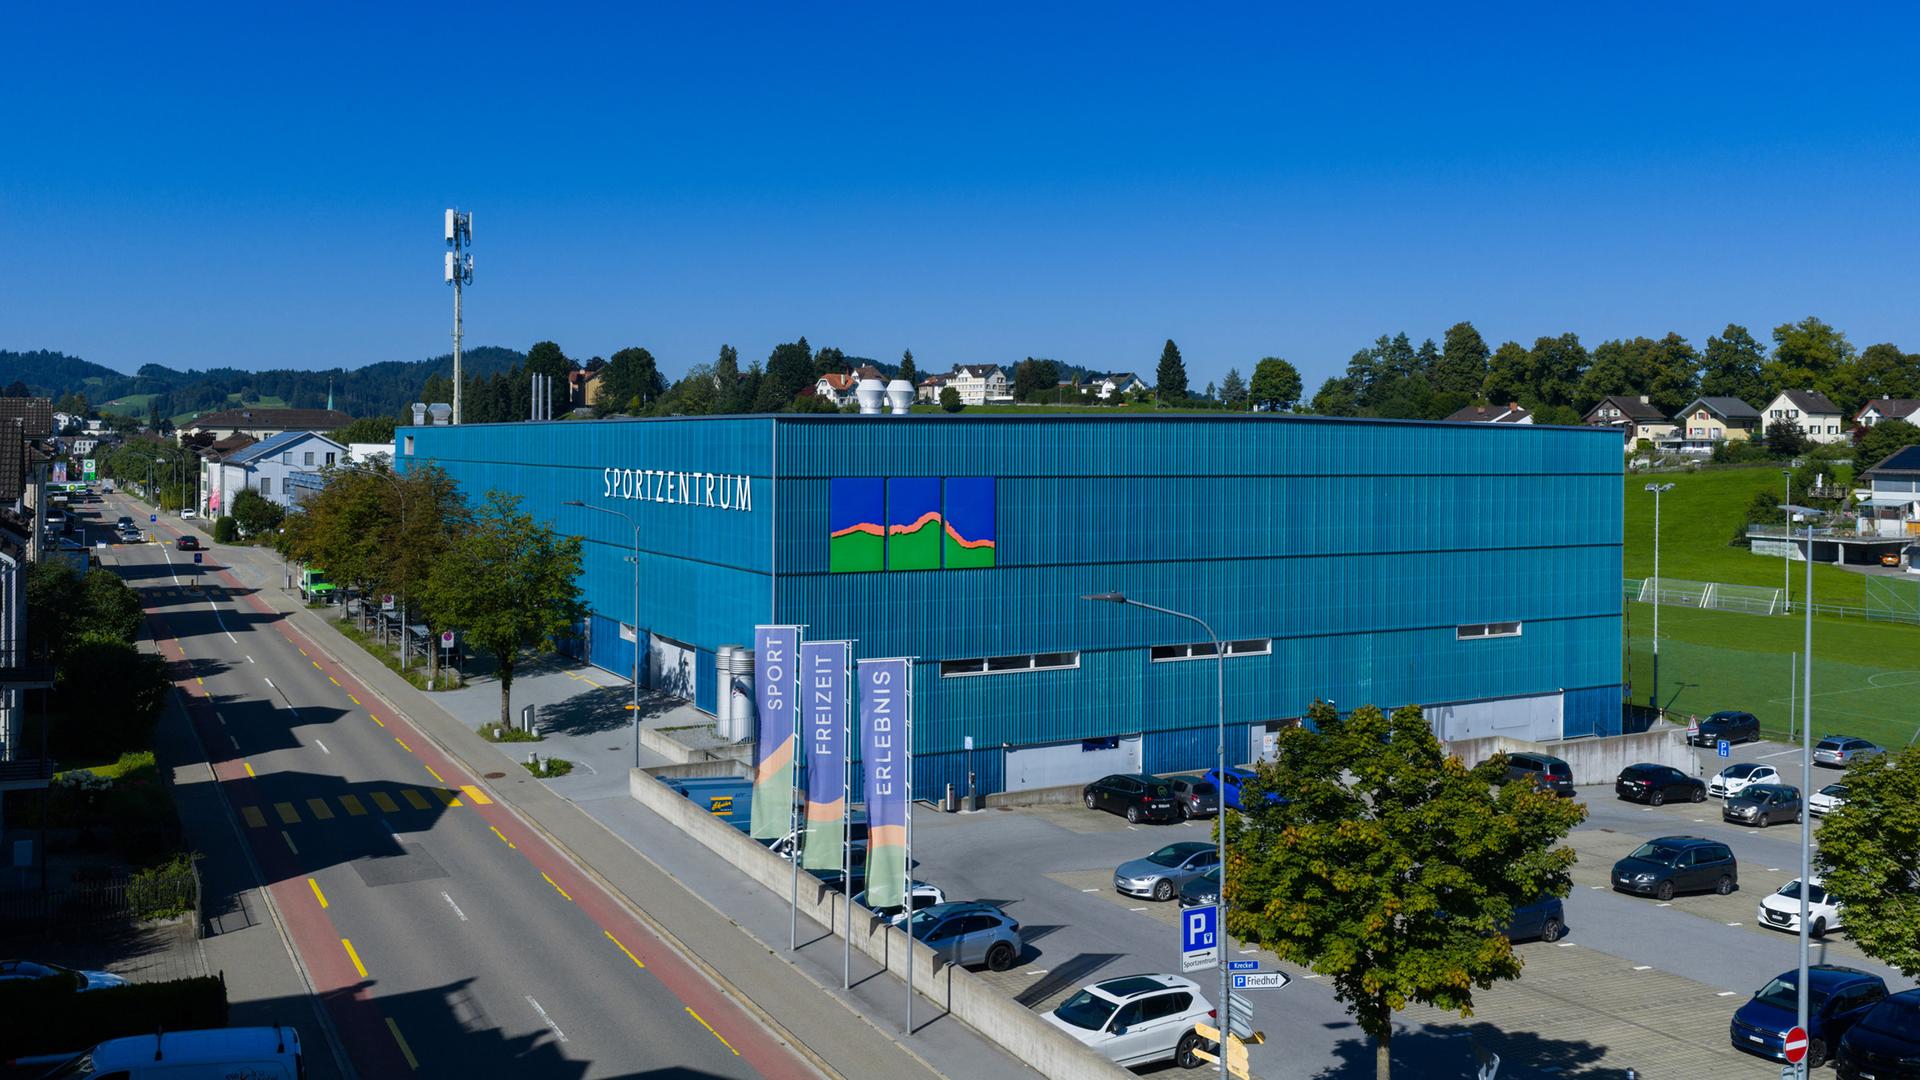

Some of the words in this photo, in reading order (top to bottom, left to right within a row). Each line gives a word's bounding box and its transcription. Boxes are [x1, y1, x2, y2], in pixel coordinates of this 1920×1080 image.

[604, 468, 751, 511] SPORTZENTRUM
[767, 637, 783, 710] SPORT
[816, 655, 832, 754] FREIZEIT
[873, 671, 892, 795] ERLEBNIS
[1190, 913, 1206, 945] P
[1183, 957, 1216, 968] Sportzentrum
[1237, 977, 1244, 986] P
[1247, 975, 1279, 986] Friedhof
